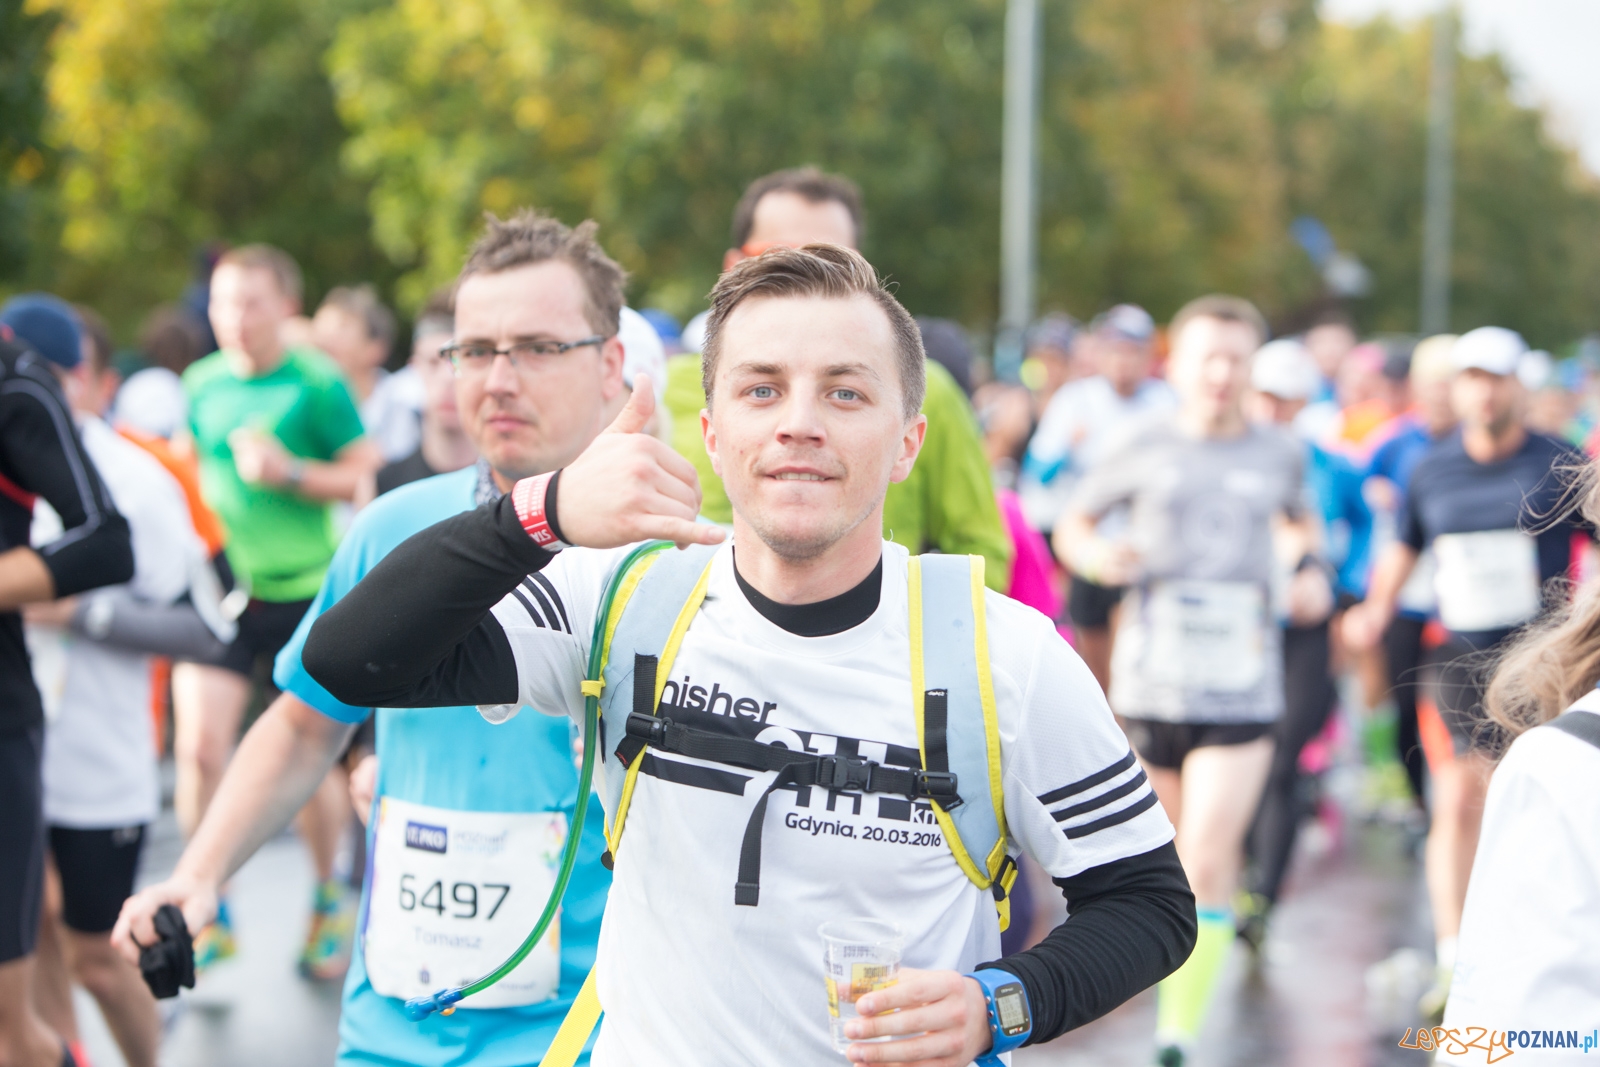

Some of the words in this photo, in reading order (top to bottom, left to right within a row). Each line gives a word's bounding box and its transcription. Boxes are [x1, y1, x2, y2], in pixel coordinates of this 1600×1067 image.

[661, 676, 777, 724] nisher
[785, 812, 857, 839] Gdynia,
[862, 826, 942, 848] 20.03.2016
[400, 873, 510, 921] 6497
[414, 926, 482, 950] Tomasz
